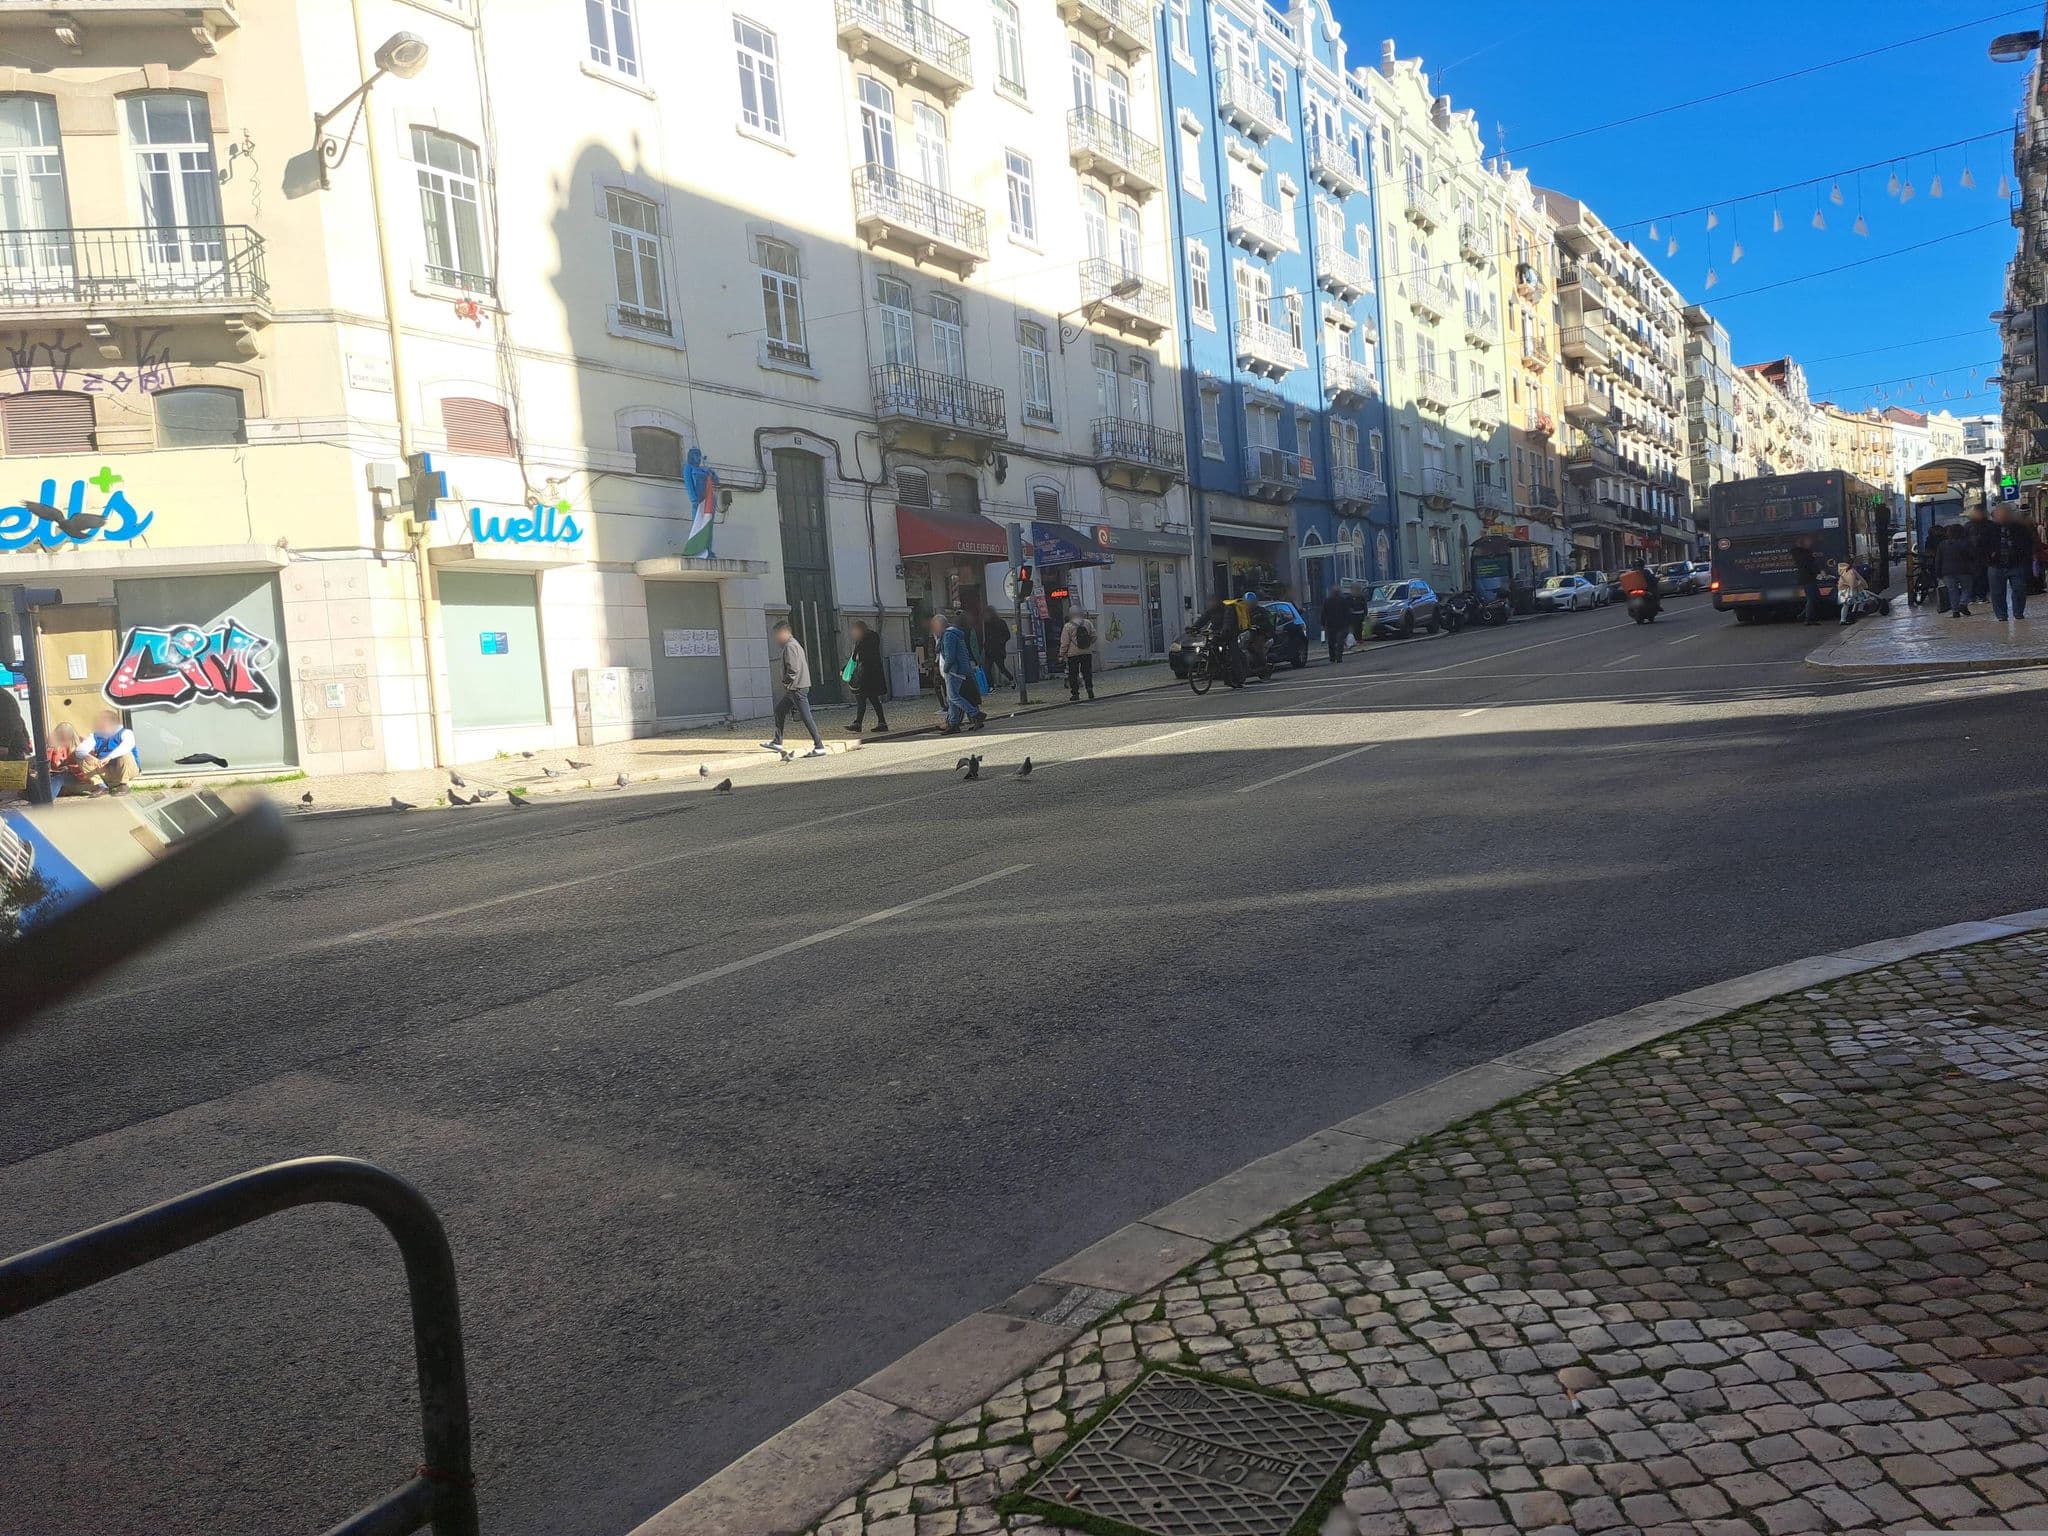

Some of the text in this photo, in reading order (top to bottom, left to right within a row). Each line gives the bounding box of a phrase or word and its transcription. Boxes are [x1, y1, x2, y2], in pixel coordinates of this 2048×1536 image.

[2003, 486, 2015, 500] P
[0, 479, 154, 550] ells
[470, 503, 583, 543] wells
[957, 541, 1000, 553] CABELEIREIRO
